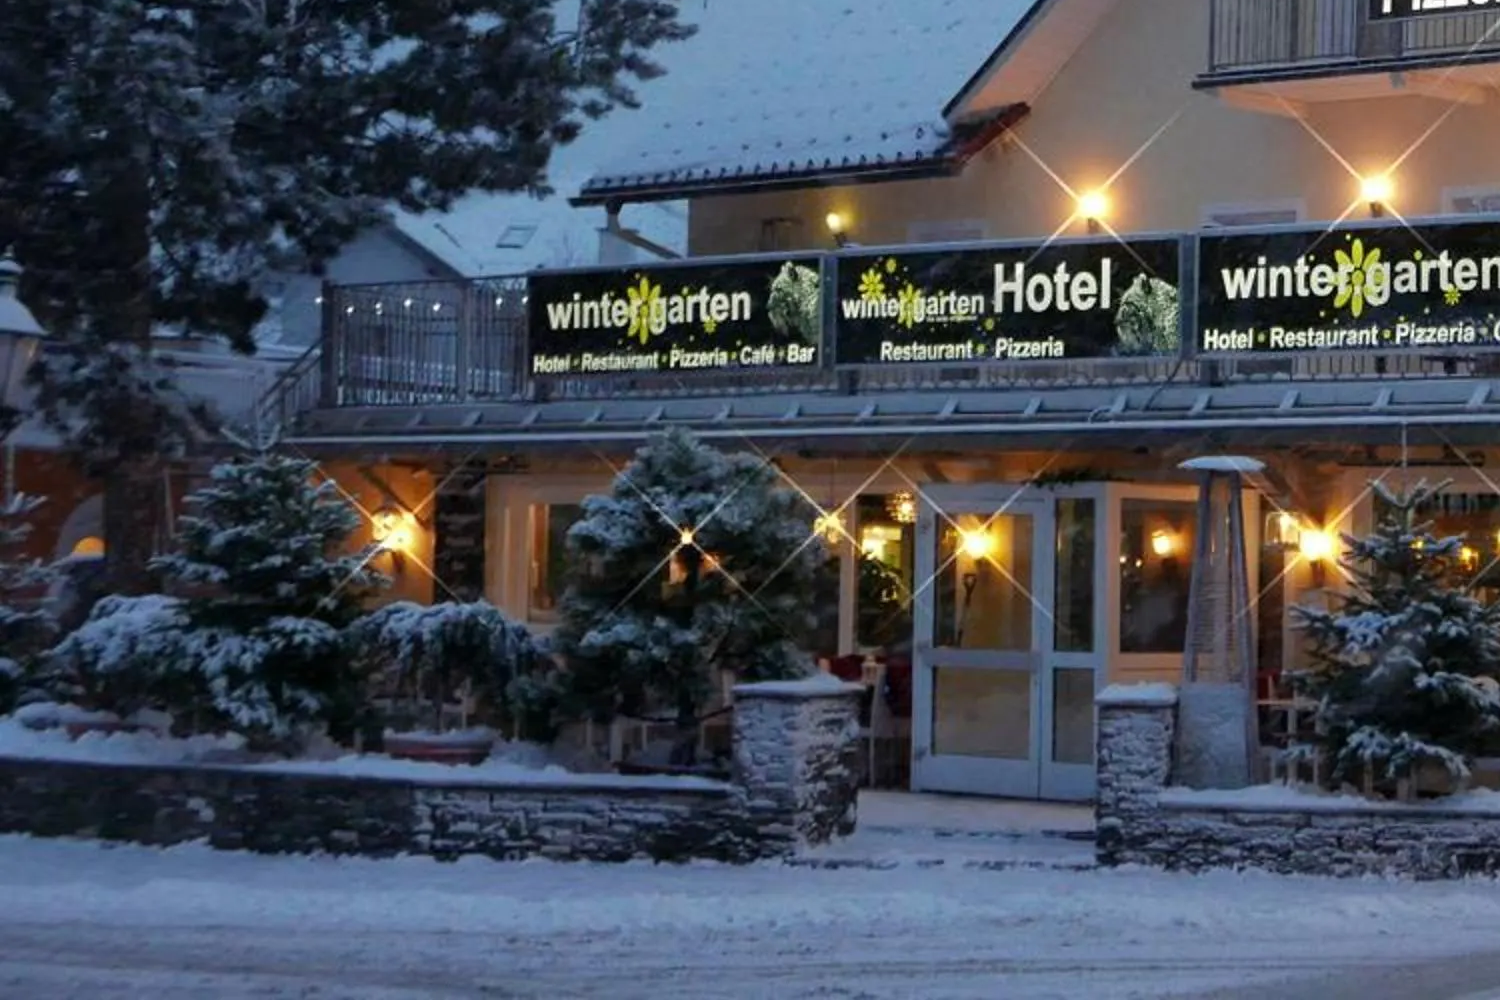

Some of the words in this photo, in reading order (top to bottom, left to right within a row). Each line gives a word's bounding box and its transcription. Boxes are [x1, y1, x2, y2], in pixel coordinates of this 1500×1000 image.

[993, 257, 1112, 314] Hotel
[880, 339, 974, 361] Restaurant
[995, 336, 1065, 358] Pizzeria
[1203, 328, 1254, 350] Hotel
[1269, 324, 1379, 348] Restaurant
[1395, 321, 1476, 344] Pizzeria
[533, 353, 571, 374] Hotel
[581, 351, 659, 372] Restaurant
[669, 347, 729, 369] Pizzeria
[740, 345, 775, 366] Café
[787, 343, 816, 364] Bar
